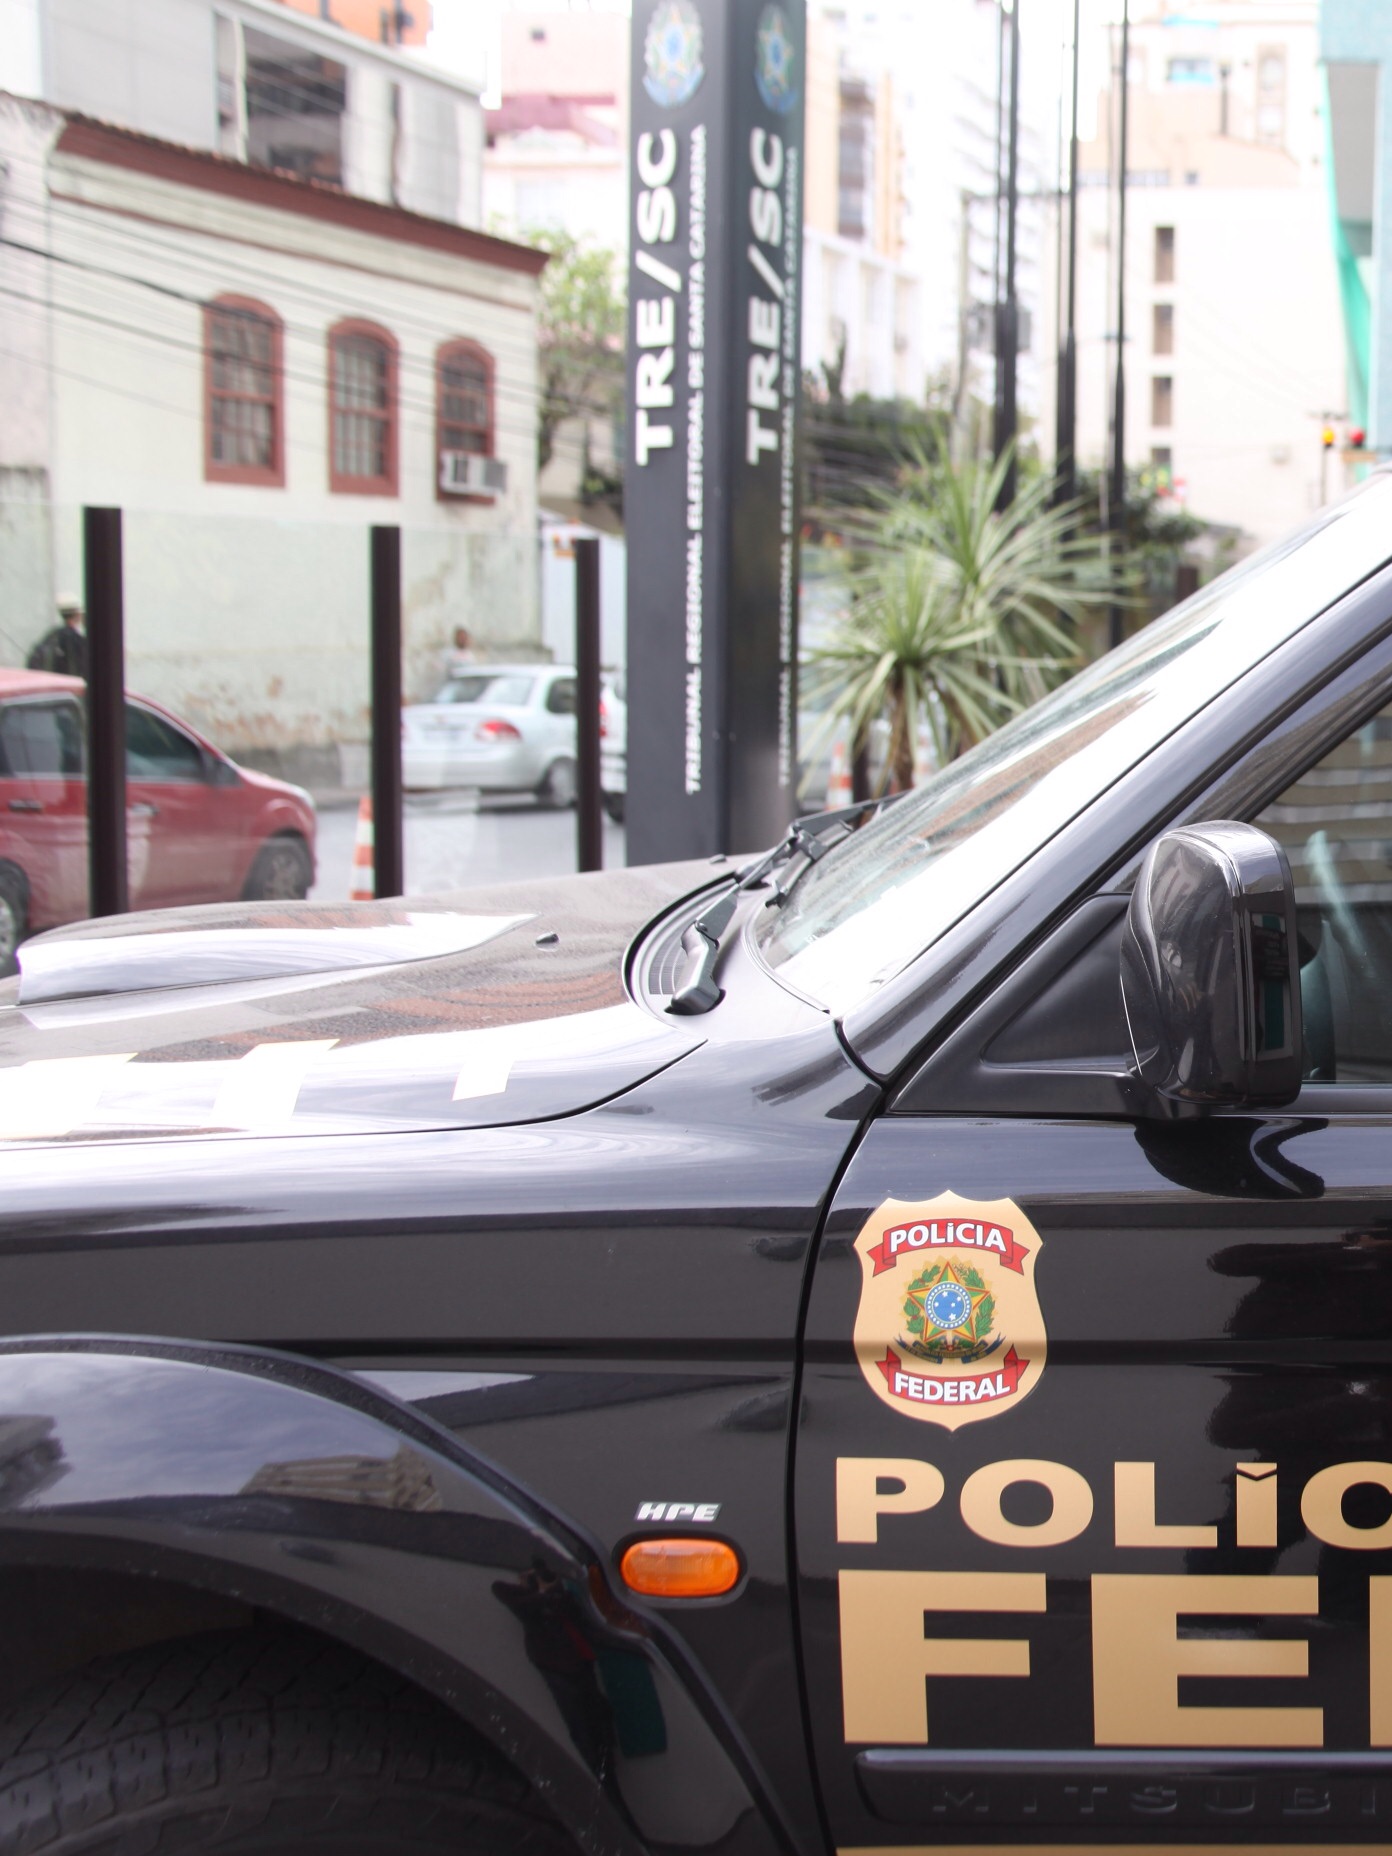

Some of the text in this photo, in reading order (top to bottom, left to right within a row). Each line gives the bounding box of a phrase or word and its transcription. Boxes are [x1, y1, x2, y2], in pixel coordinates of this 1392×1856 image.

[635, 128, 681, 467] TRE/SC
[685, 124, 706, 794] TRIBUNAL REGIONAL ELEITORAL DE SANTA CATARINA
[746, 127, 786, 466] TRE/SC
[636, 1502, 720, 1521] HPE
[894, 1372, 1010, 1403] FEDERAL
